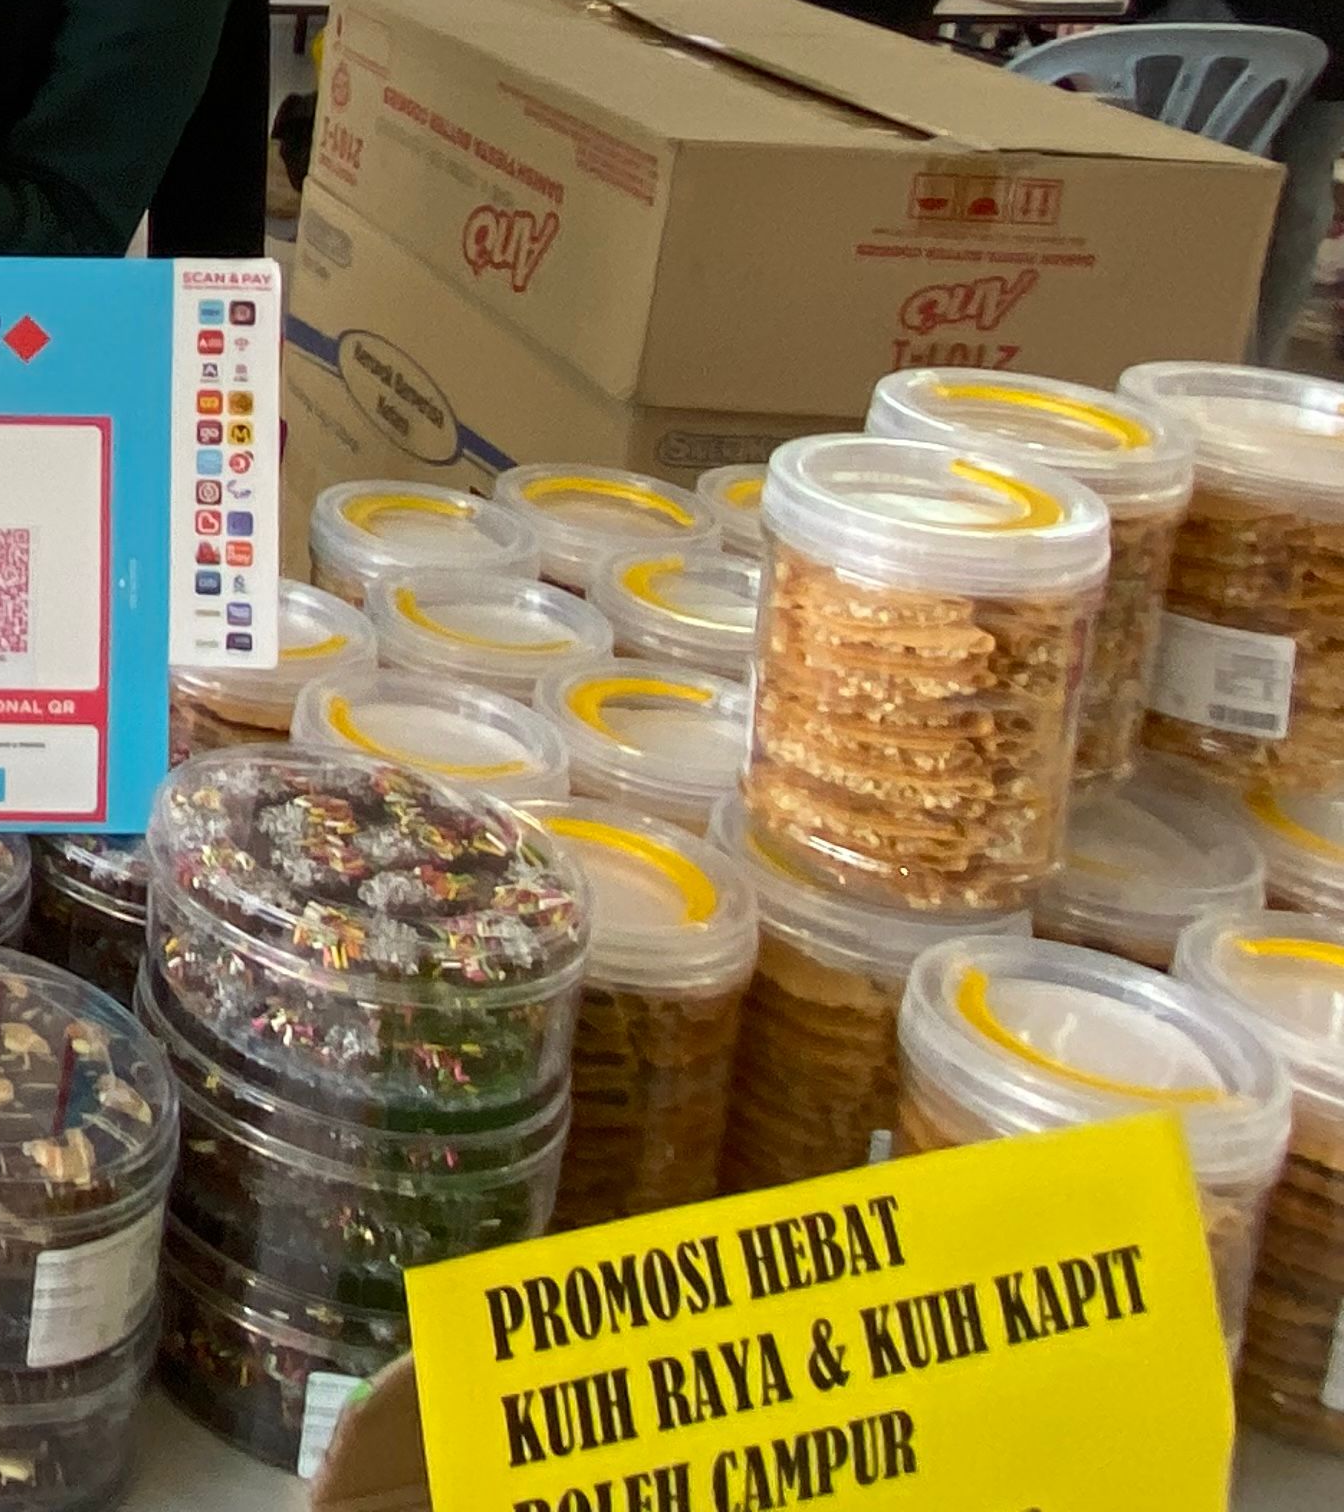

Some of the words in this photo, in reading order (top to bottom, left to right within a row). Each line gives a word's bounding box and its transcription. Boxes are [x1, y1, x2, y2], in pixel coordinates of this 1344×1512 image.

[182, 271, 226, 286] SCAN
[229, 272, 240, 285] &
[241, 273, 272, 286] PAY
[48, 699, 75, 716] QR
[484, 1234, 729, 1361] PROMOSI
[736, 1195, 907, 1300] HEBAT
[501, 1366, 638, 1468] KUIH
[648, 1333, 792, 1431] RAYA
[807, 1319, 851, 1392] &
[858, 1283, 987, 1380] KUIH
[996, 1244, 1147, 1344] KAPIT
[711, 1409, 917, 1512] CAMPUR
